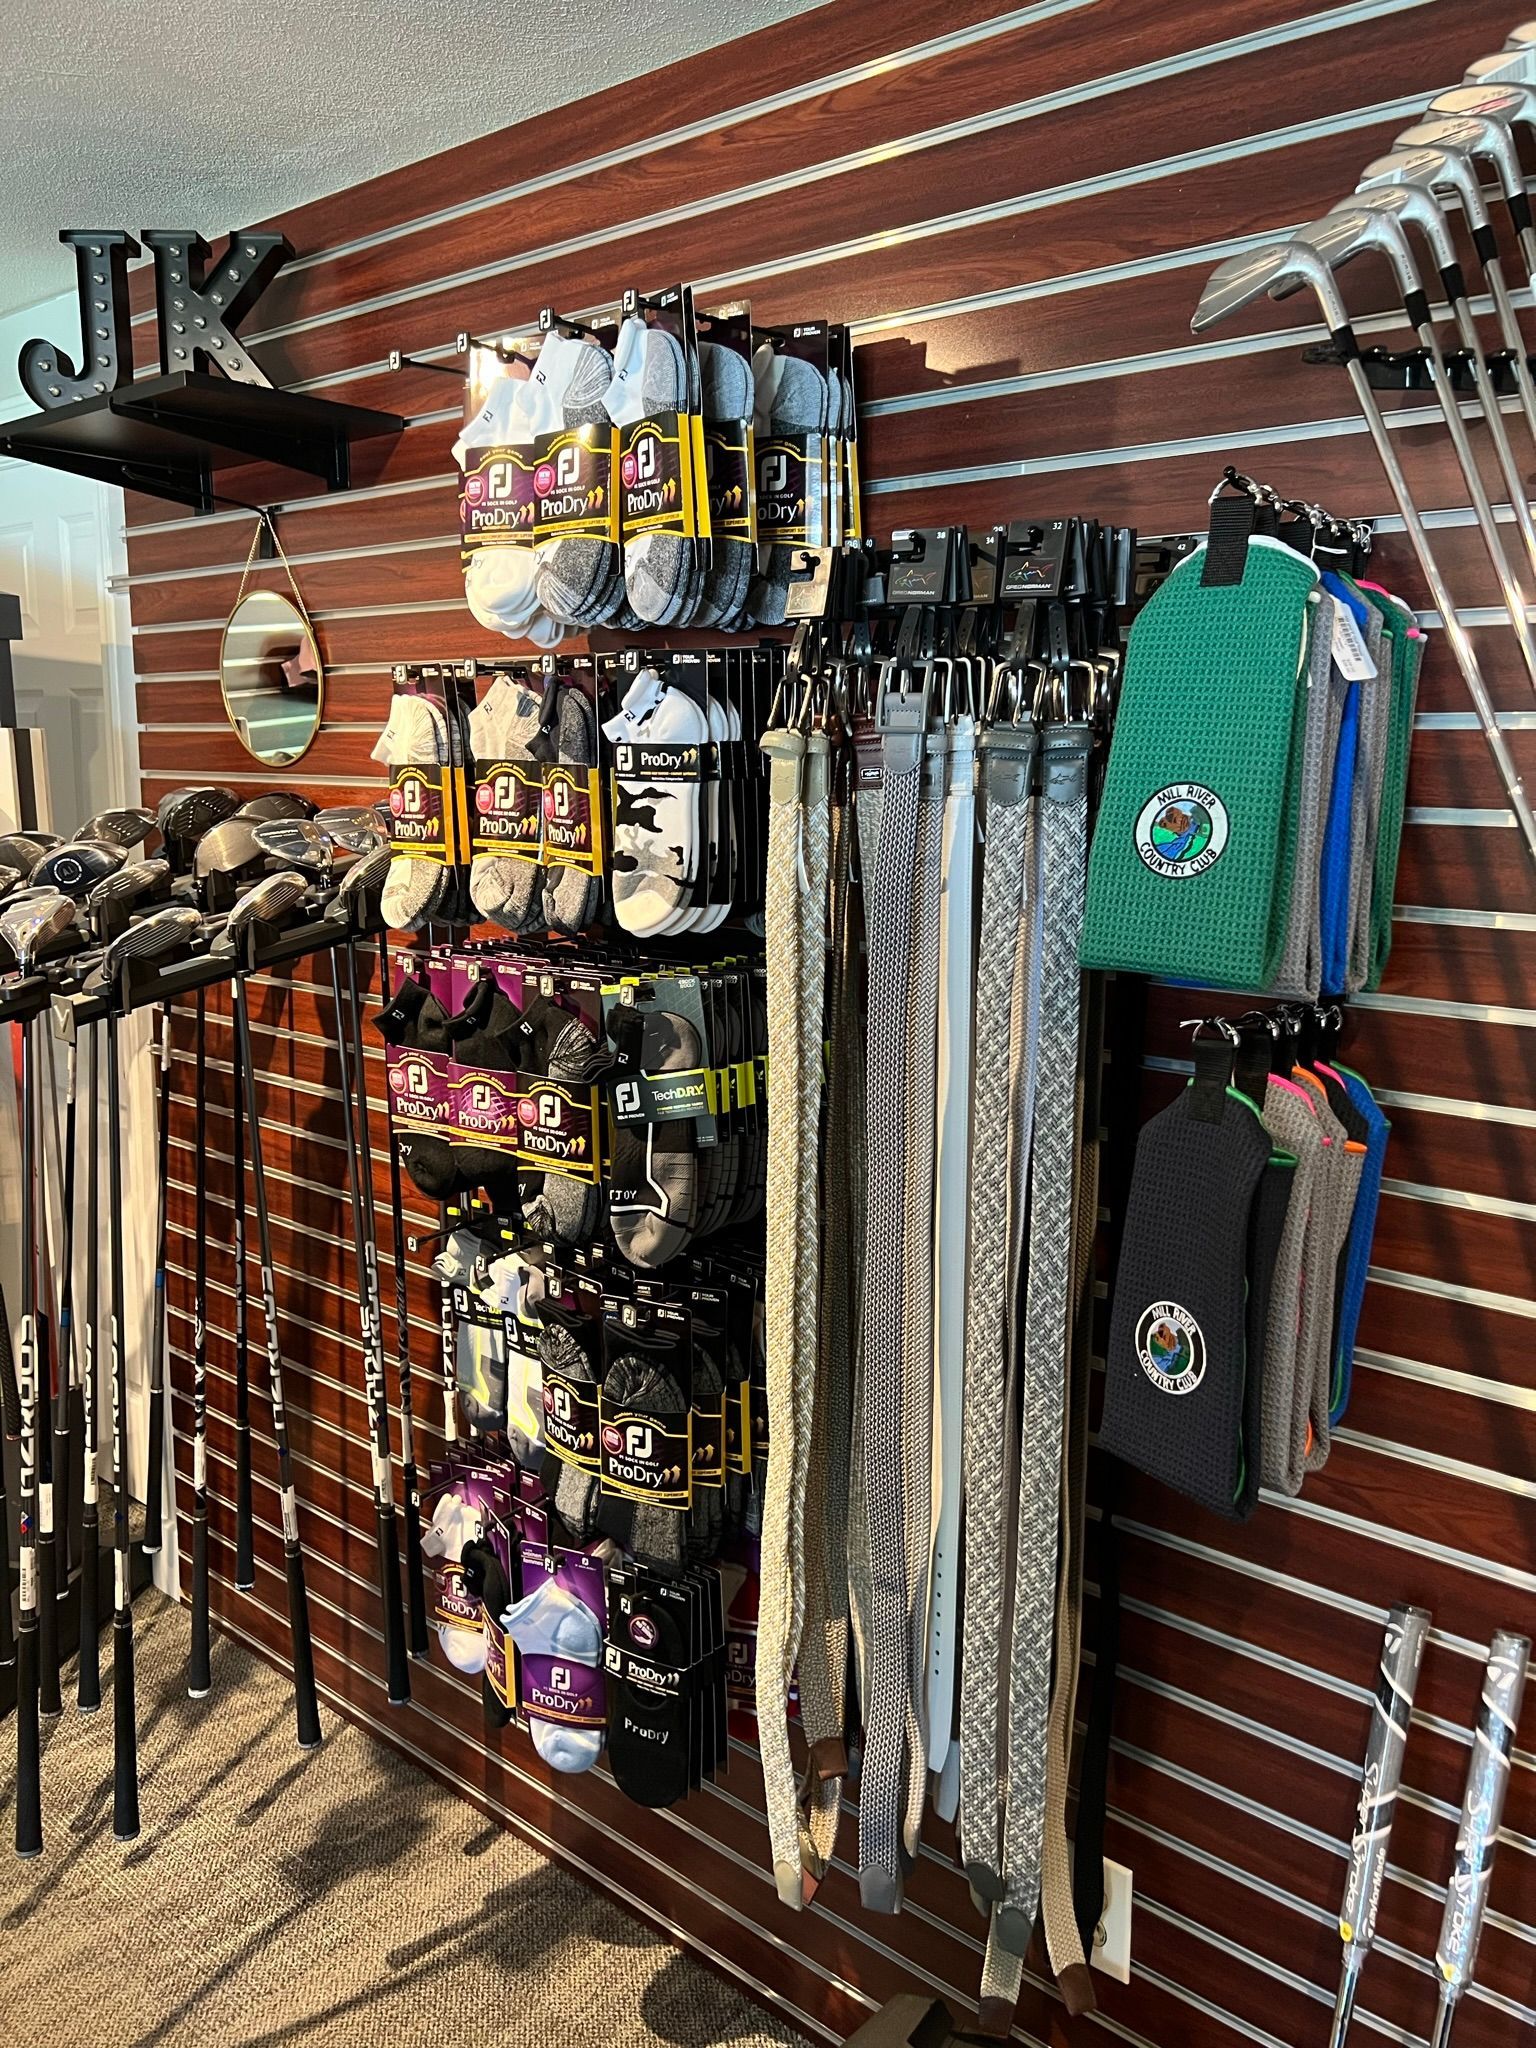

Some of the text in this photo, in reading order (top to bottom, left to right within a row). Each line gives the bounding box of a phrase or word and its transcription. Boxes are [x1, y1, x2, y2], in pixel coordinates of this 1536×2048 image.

[623, 289, 635, 311] FJ
[539, 310, 550, 330] FJ
[456, 332, 468, 353] FJ
[536, 370, 547, 385] FJ
[557, 448, 580, 486] FJ
[637, 437, 655, 480] FJ
[488, 463, 513, 499] FJ
[761, 455, 787, 492] FJ
[541, 495, 589, 517] ProDry
[627, 488, 665, 512] ProDry
[471, 509, 521, 529] ProDry
[1052, 522, 1063, 530] 32
[986, 536, 995, 545] 34
[464, 659, 475, 677] FJ
[543, 655, 553, 673] FJ
[625, 651, 637, 671] FJ
[624, 710, 635, 722] FJ
[616, 745, 633, 771] FJ
[640, 752, 682, 769] ProDry
[403, 780, 420, 812] FJ
[494, 776, 515, 809] FJ
[553, 782, 569, 817] FJ
[1157, 785, 1216, 810] MILL RIVER
[394, 821, 428, 840] ProDry
[479, 817, 522, 838] ProDry
[548, 827, 576, 848] ProDry
[1140, 842, 1217, 875] COUNTRY CLUB
[403, 957, 413, 974] FJ
[468, 964, 479, 981] FJ
[541, 977, 553, 995] FJ
[520, 1021, 533, 1035] FJ
[618, 1052, 629, 1064] FJ
[408, 1064, 429, 1094] FJ
[472, 1084, 491, 1110] FJ
[615, 1081, 641, 1112] FJ
[396, 1097, 438, 1120] ProDry
[539, 1094, 561, 1128] FJ
[458, 1110, 501, 1133] ProDry
[523, 1130, 570, 1158] ProDry
[475, 1255, 485, 1271] FJ
[453, 1288, 469, 1313] FJ
[549, 1280, 561, 1298] FJ
[622, 1305, 636, 1328] FJ
[1152, 1305, 1196, 1336] MILL RIVER
[505, 1316, 518, 1343] FJ
[1140, 1349, 1198, 1391] COUNTRY CLUB
[553, 1387, 572, 1421] FJ
[546, 1416, 580, 1451] ProDry
[626, 1425, 652, 1458] FJ
[625, 1455, 639, 1464] SOCK
[609, 1456, 663, 1488] ProDry
[411, 1492, 420, 1507] FJ
[544, 1557, 554, 1573] FJ
[442, 1597, 477, 1619] ProDry
[620, 1596, 631, 1615] FJ
[605, 1647, 621, 1671] FJ
[551, 1666, 571, 1691] FJ
[628, 1661, 667, 1686] ProDry
[531, 1687, 579, 1714] ProDry
[624, 1716, 669, 1744] ProDry
